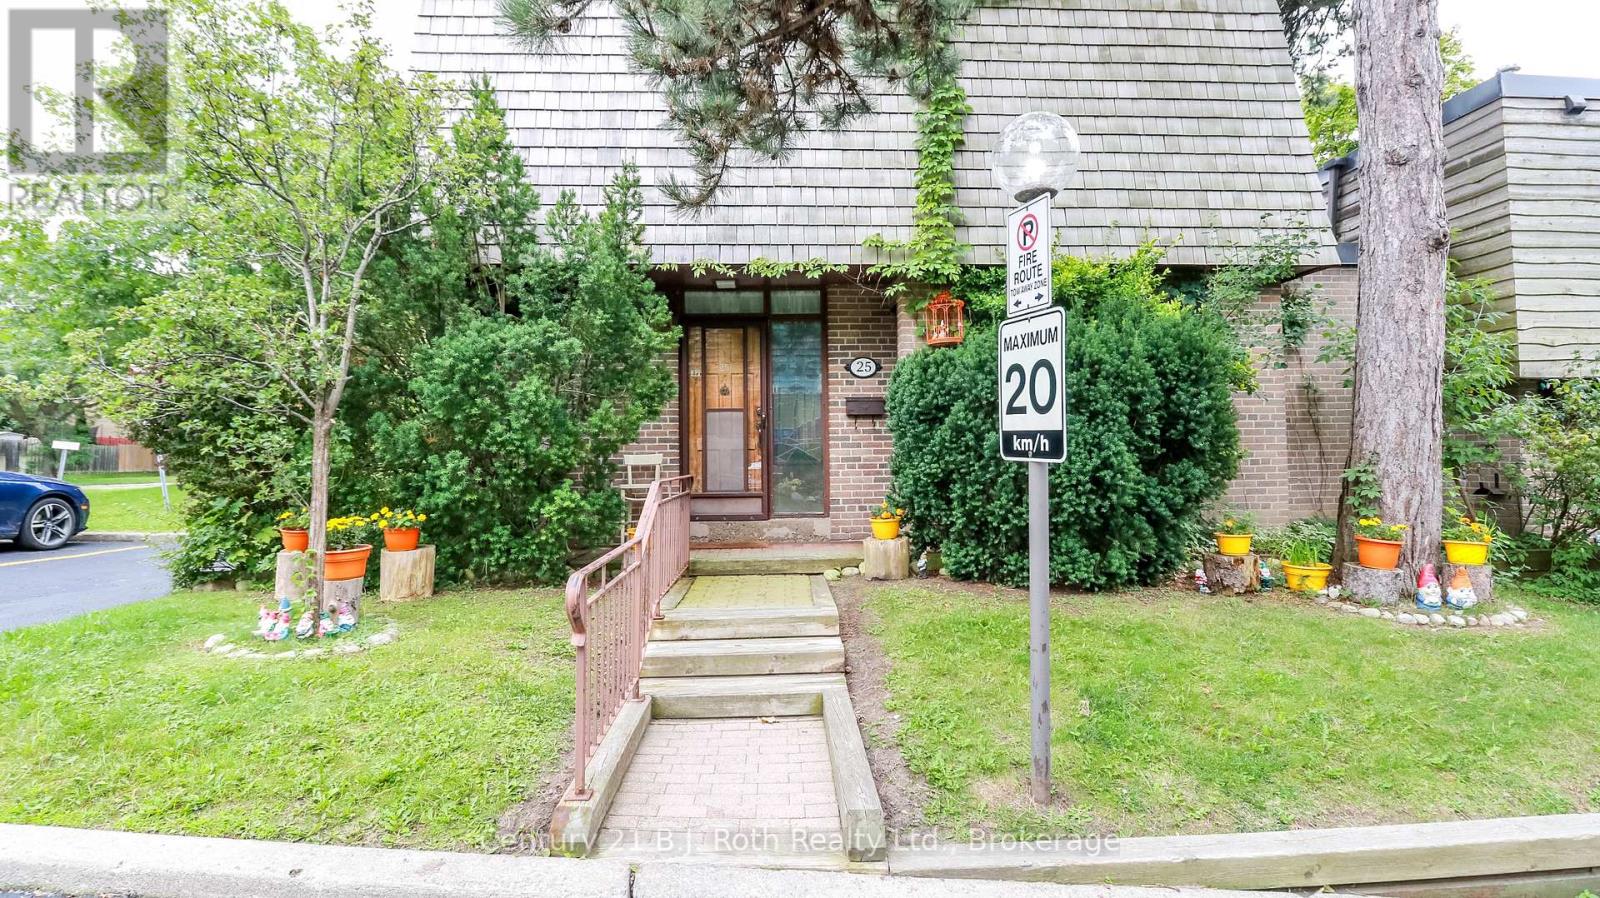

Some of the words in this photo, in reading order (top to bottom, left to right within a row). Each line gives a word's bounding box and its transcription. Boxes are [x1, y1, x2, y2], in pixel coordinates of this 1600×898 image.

[1018, 249, 1037, 268] FIRE
[1014, 263, 1042, 285] ROUTE
[1010, 288, 1020, 297] TOW
[1021, 283, 1033, 293] AWAY
[1034, 277, 1047, 290] ZONE
[1003, 326, 1058, 352] MAXIMUM
[856, 361, 872, 372] 25
[1005, 358, 1057, 415] 20
[1012, 433, 1049, 453] km/h
